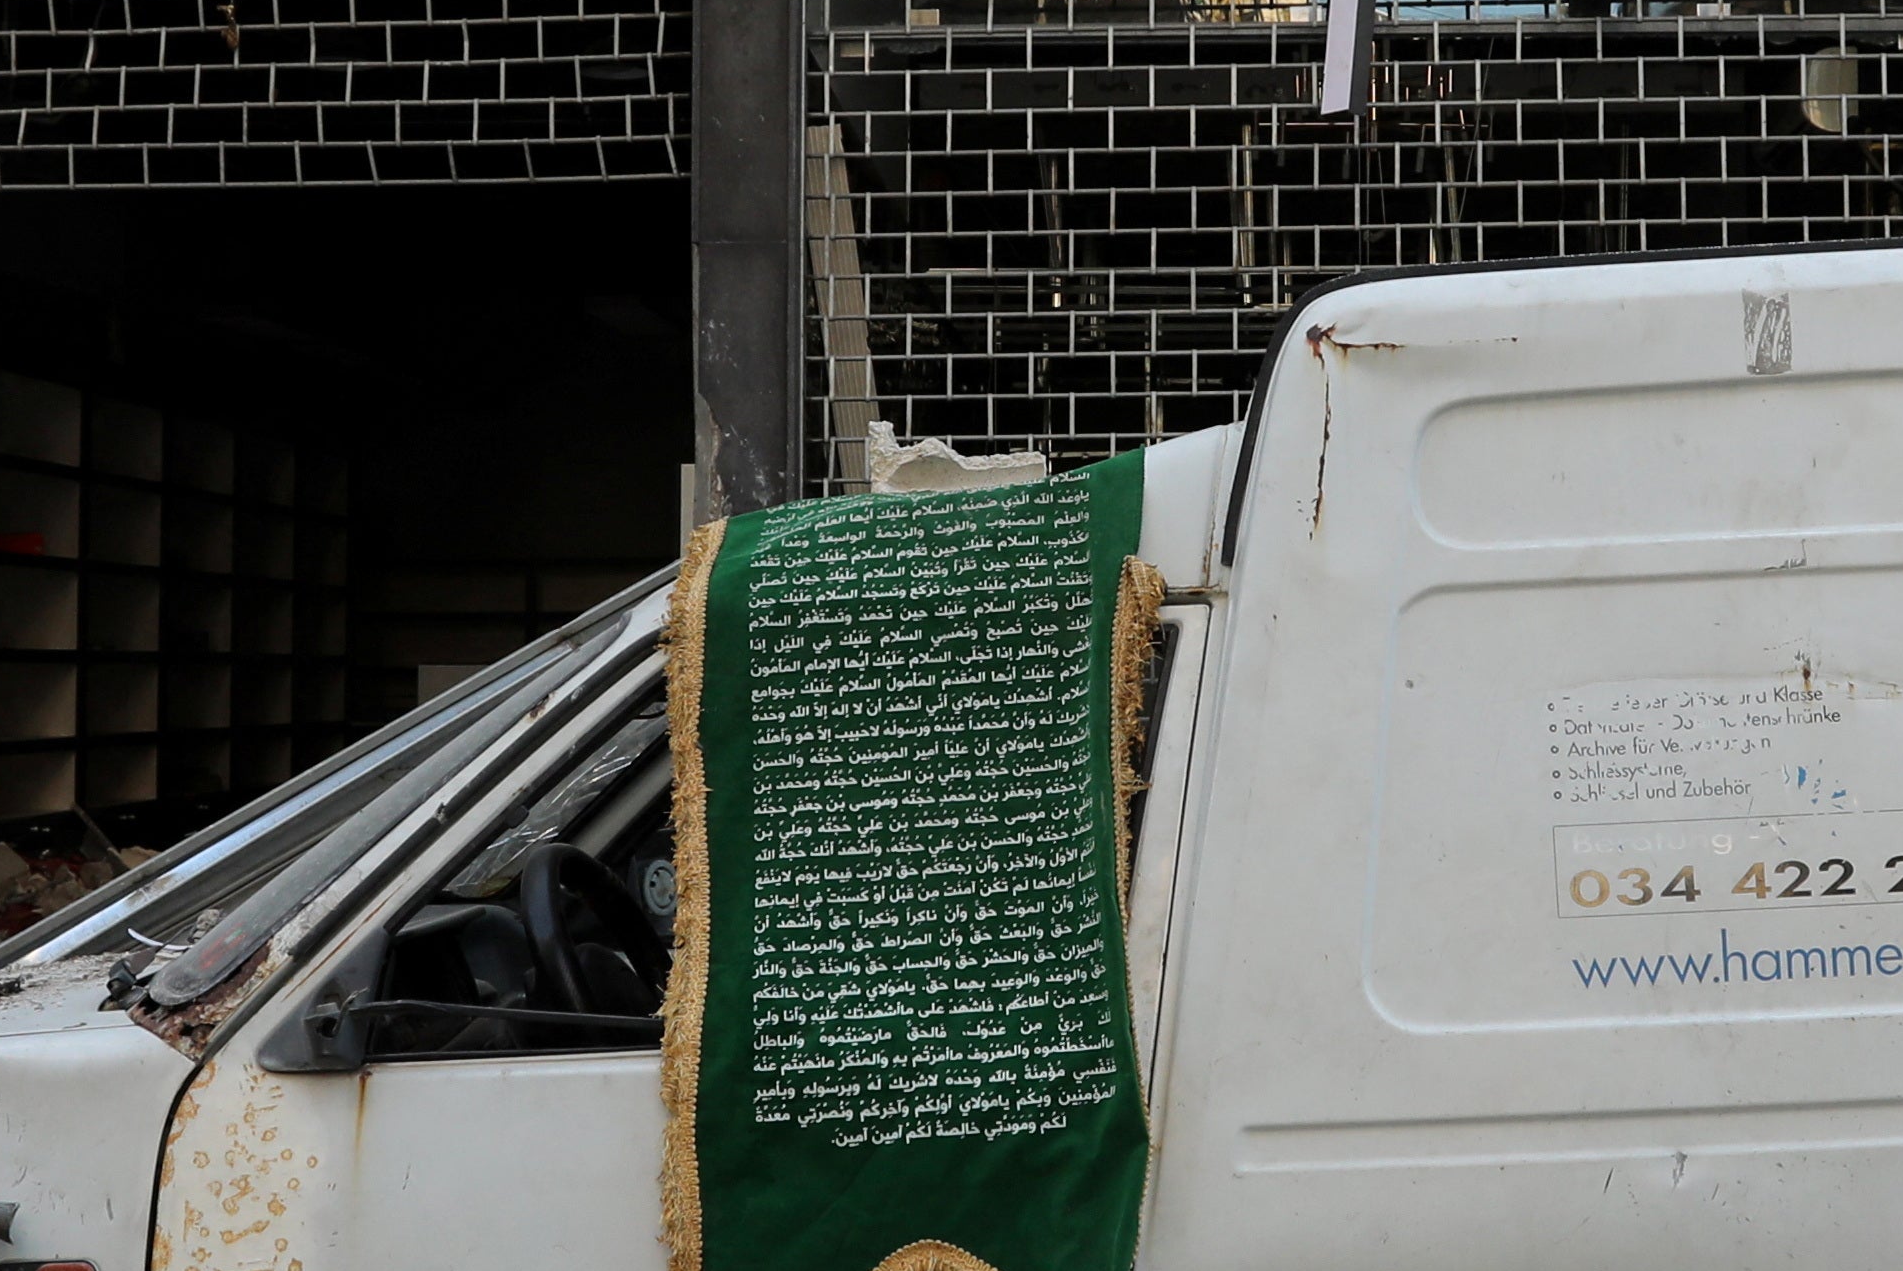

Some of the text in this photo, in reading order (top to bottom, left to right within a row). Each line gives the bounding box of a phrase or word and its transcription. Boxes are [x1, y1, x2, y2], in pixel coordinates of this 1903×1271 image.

[1773, 685, 1824, 703] Klasse
[1567, 741, 1627, 758] Archive
[1646, 782, 1676, 800] und
[1683, 777, 1752, 799] Zubehör
[1569, 864, 1701, 909] 034
[1732, 858, 1857, 900] 422
